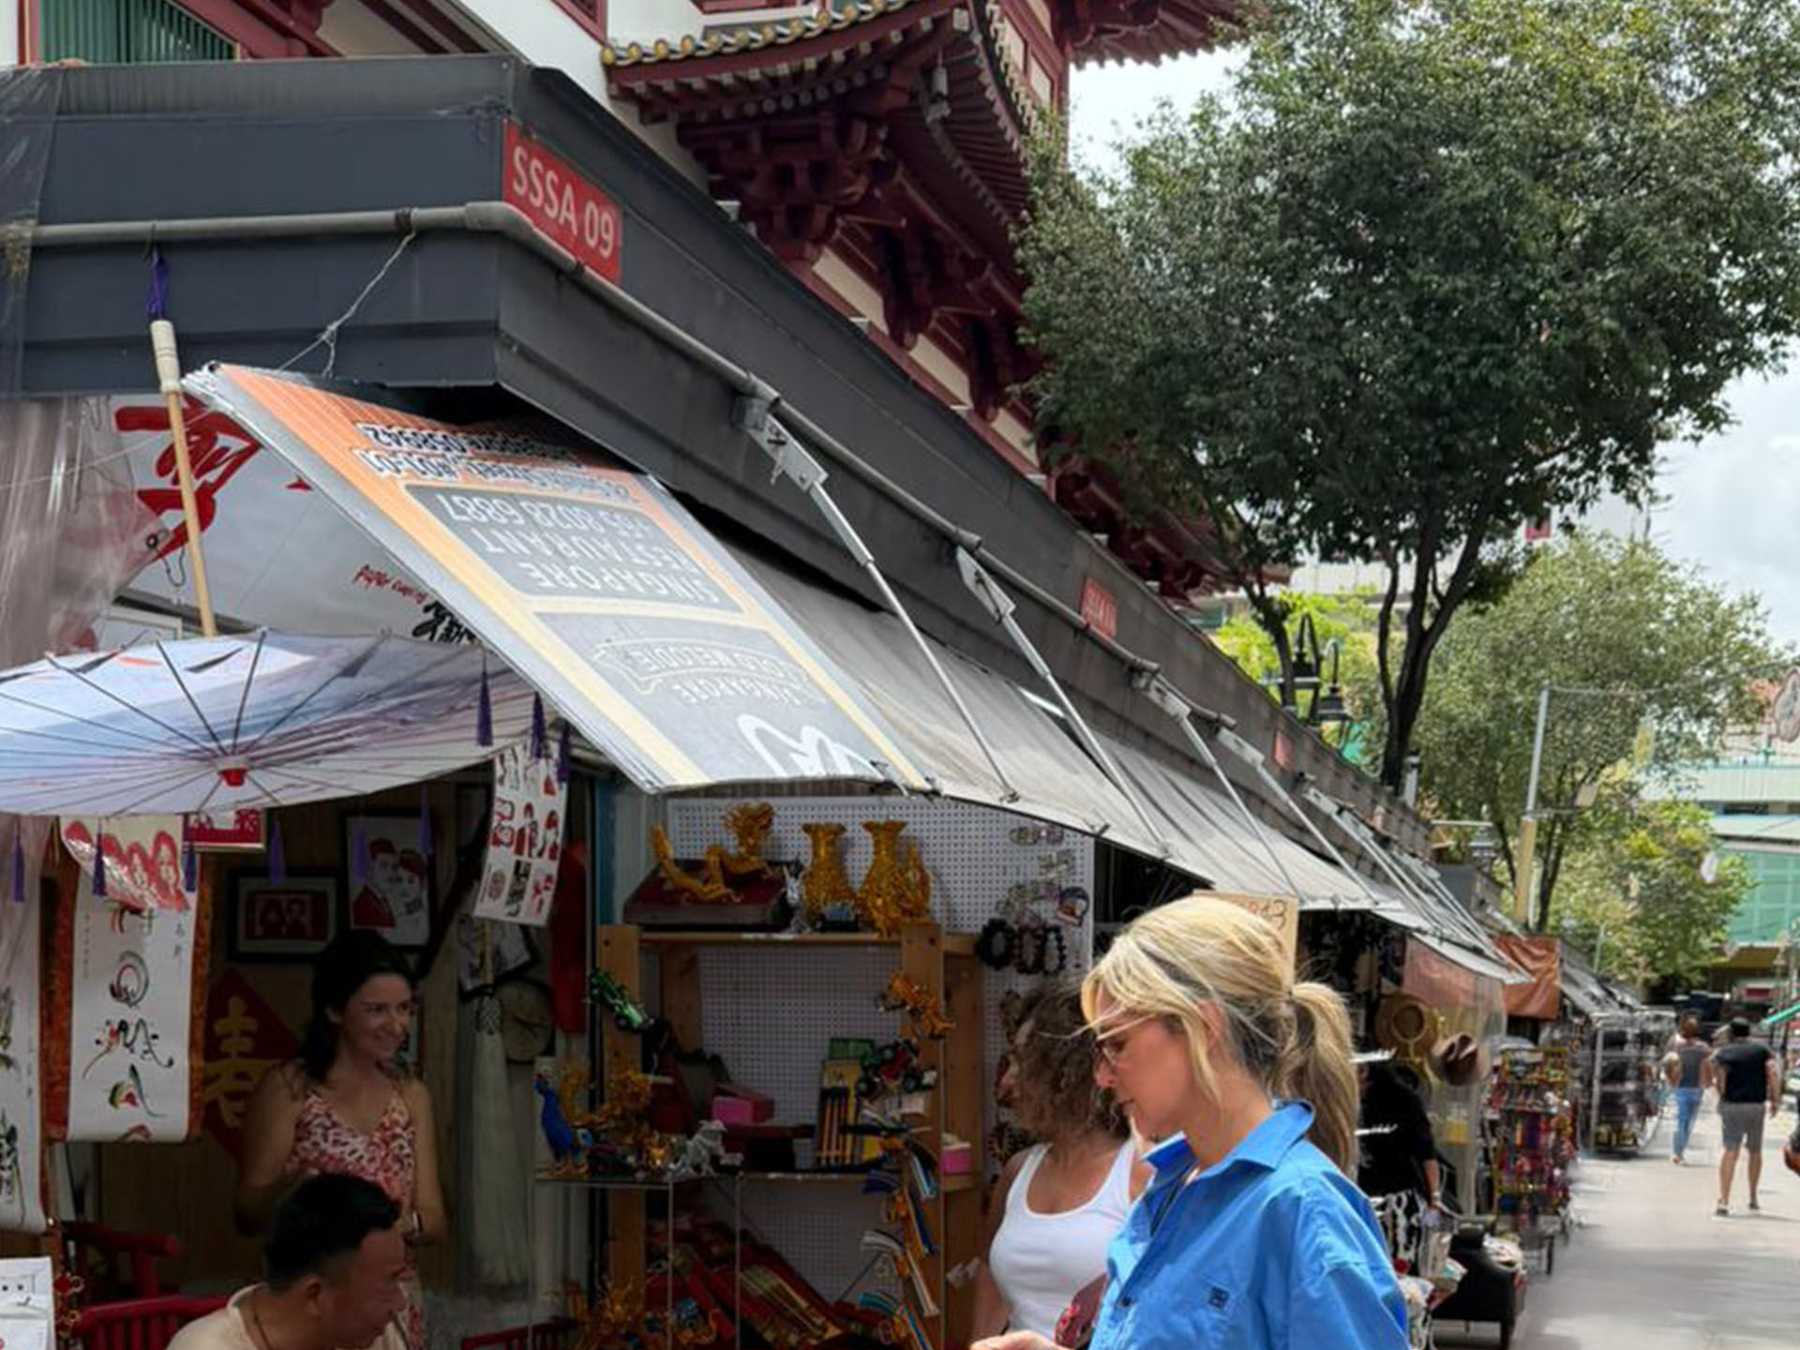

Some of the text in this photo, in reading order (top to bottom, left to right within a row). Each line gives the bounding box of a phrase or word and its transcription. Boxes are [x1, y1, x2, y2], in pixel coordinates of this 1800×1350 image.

[512, 145, 614, 260] SSSA 09
[435, 493, 525, 526] 6887
[519, 499, 606, 533] 8028
[470, 526, 706, 575] RESTAURANT
[518, 560, 727, 603] SINGAPORE
